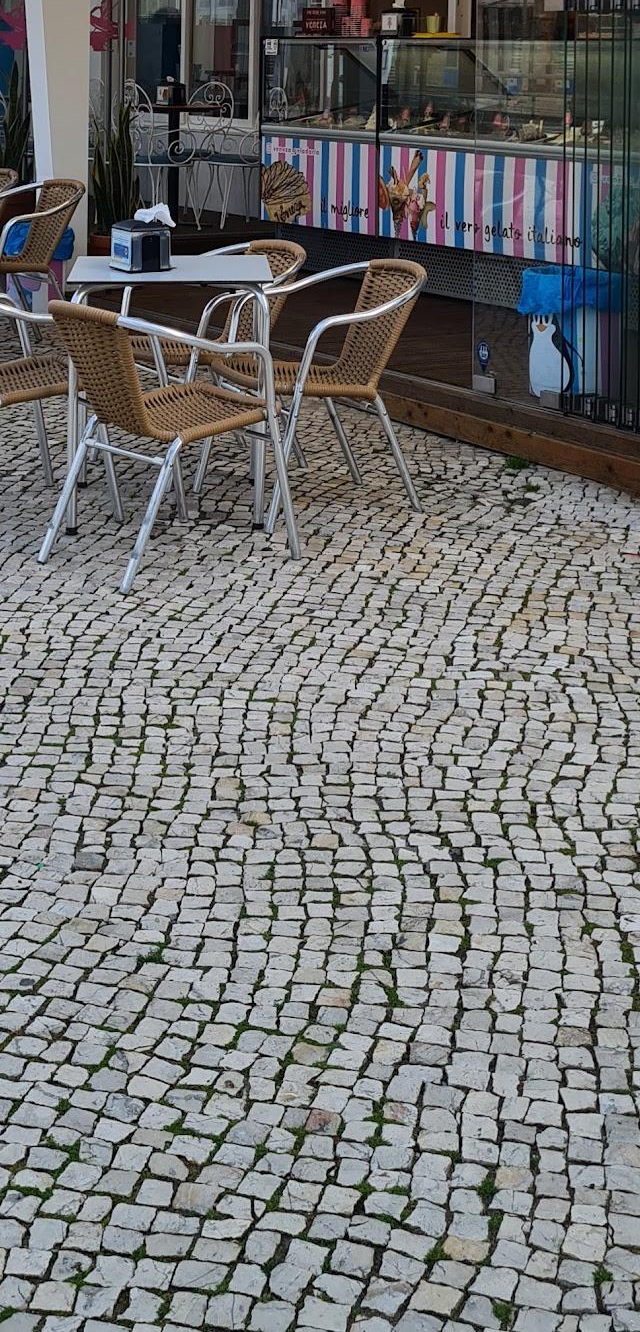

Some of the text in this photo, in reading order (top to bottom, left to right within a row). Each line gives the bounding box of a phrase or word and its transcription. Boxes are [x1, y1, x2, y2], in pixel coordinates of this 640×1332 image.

[330, 199, 370, 222] migliore
[439, 211, 584, 248] il vero gelato italiano
